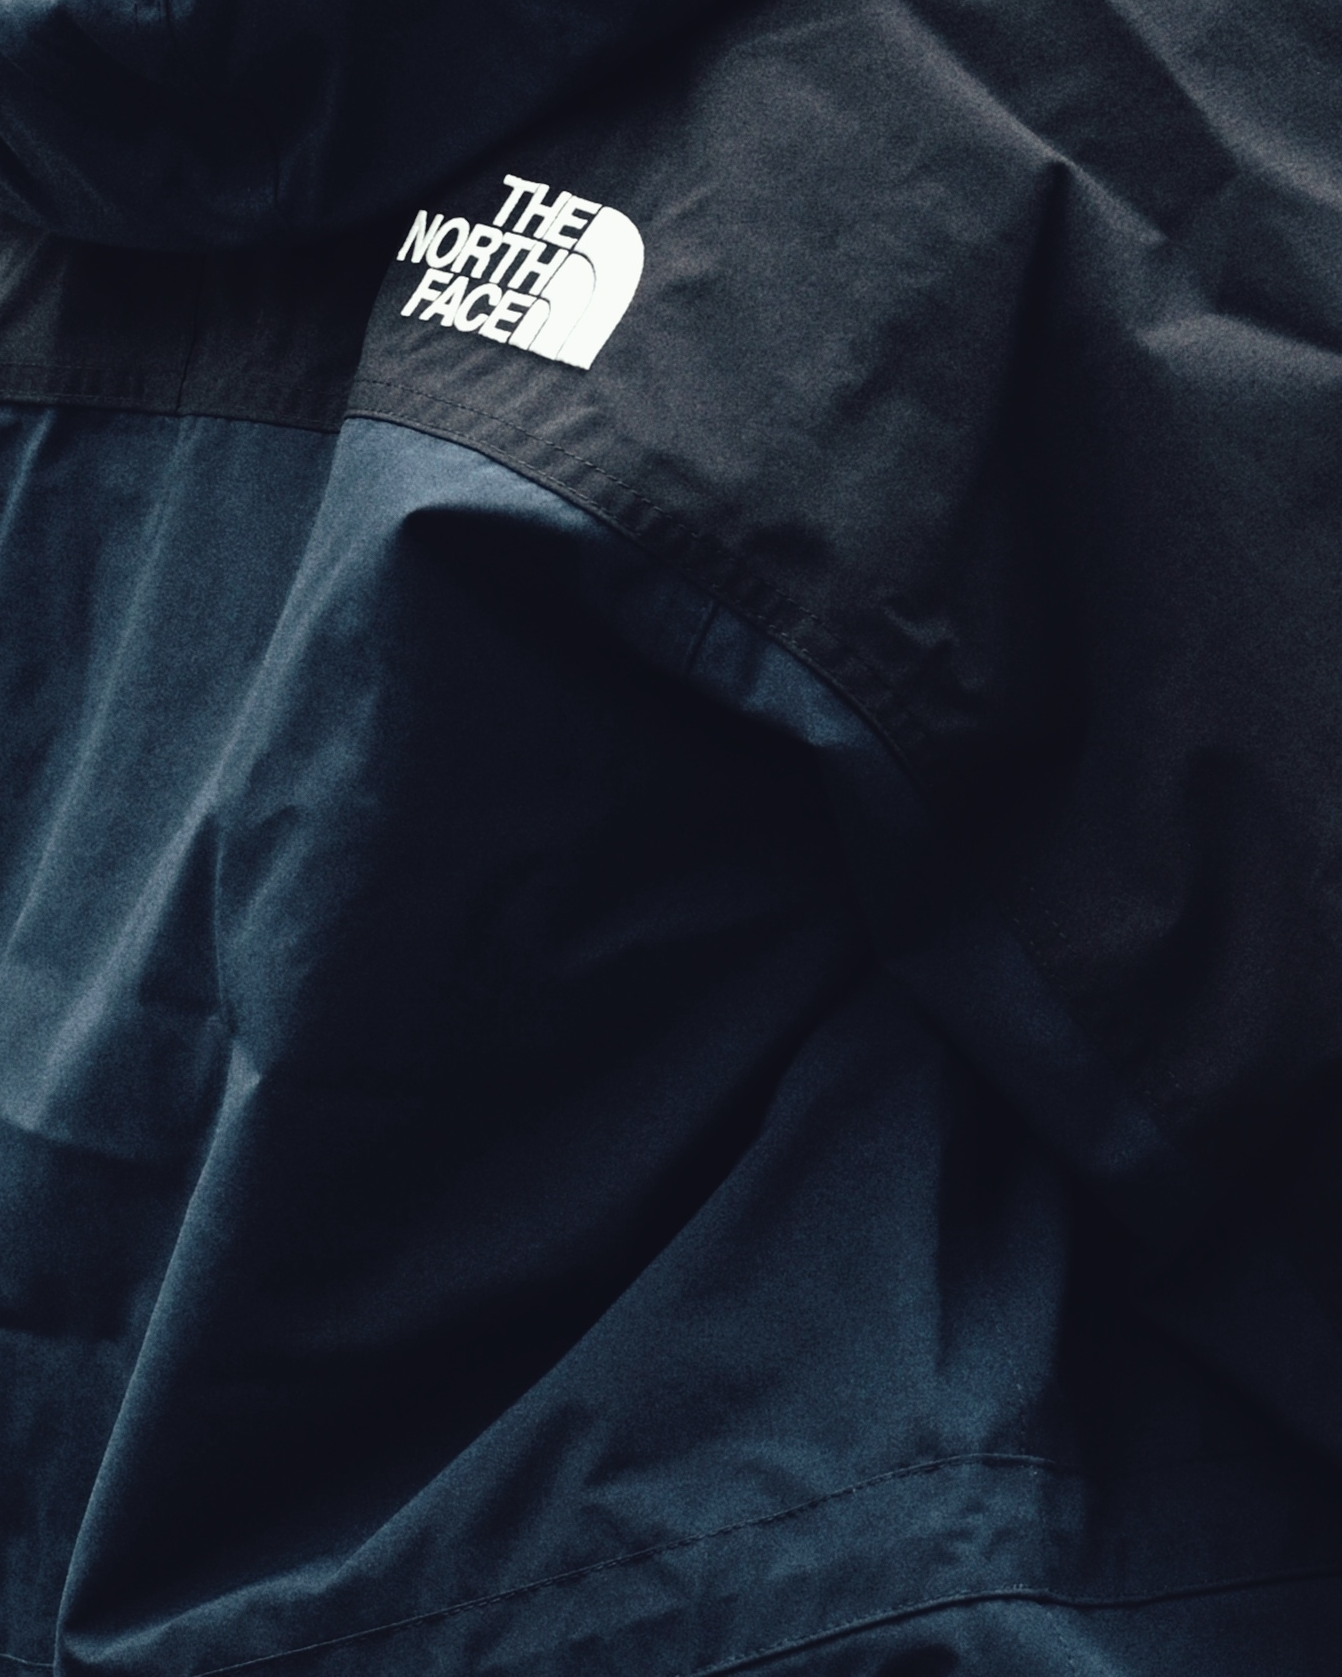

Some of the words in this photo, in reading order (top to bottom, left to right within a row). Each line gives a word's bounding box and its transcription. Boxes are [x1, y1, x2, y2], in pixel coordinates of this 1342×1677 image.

[493, 175, 602, 249] THE
[396, 210, 570, 296] NORTH
[400, 268, 538, 343] FACE
